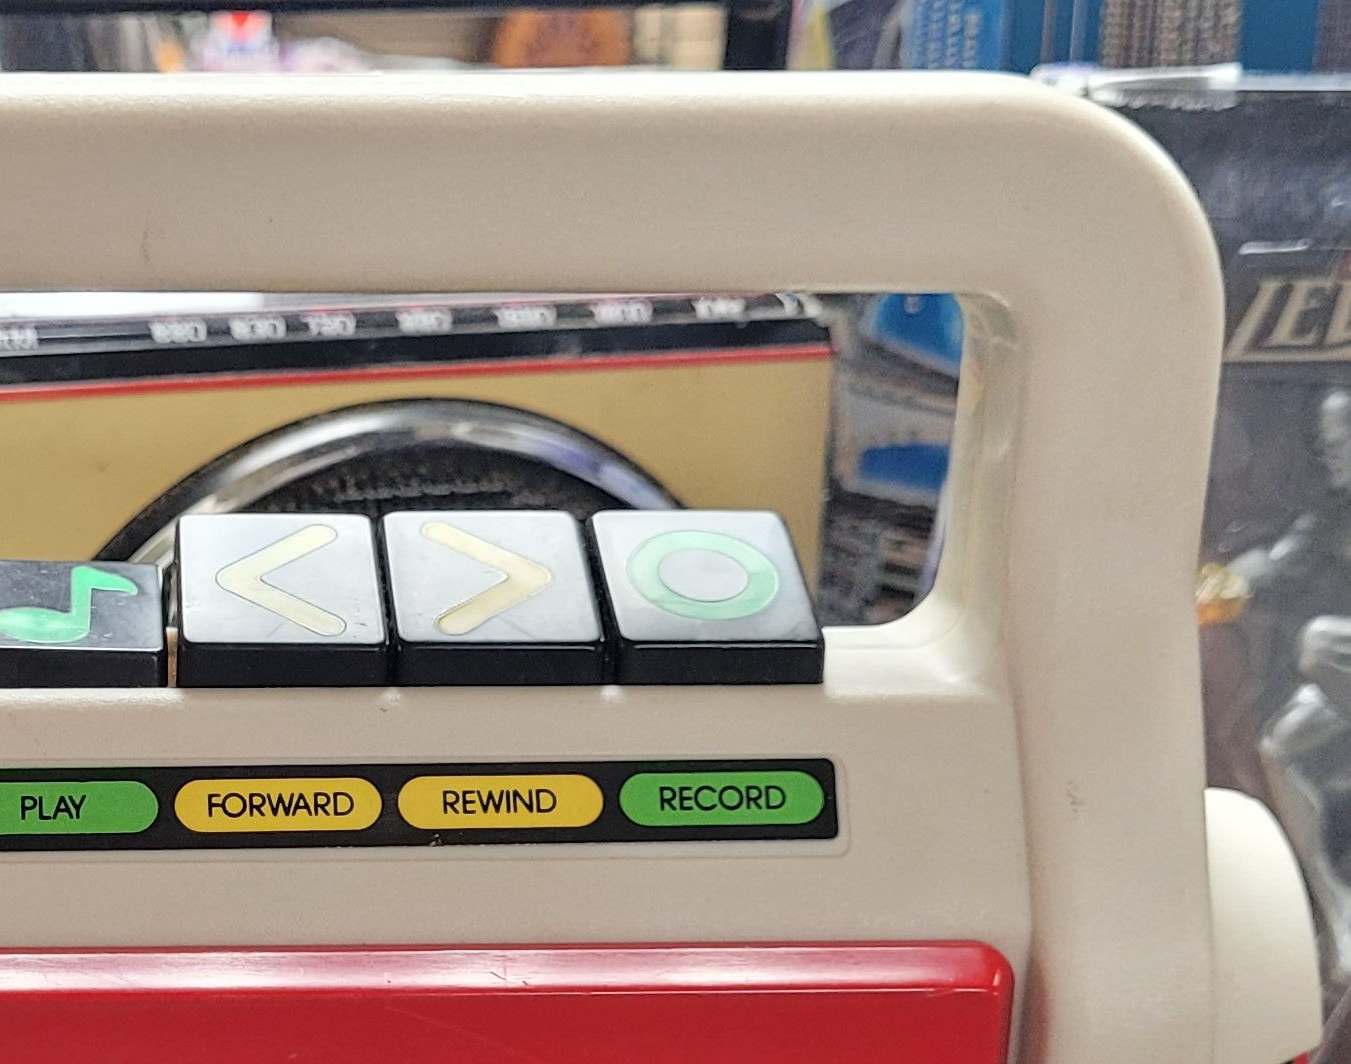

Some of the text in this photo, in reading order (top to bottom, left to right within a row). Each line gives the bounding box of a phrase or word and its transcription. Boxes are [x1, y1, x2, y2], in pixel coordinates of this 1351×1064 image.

[20, 794, 88, 821] PLAY
[207, 790, 355, 820] FORWARD
[442, 788, 557, 815] REWIND
[660, 784, 788, 812] RECORD
